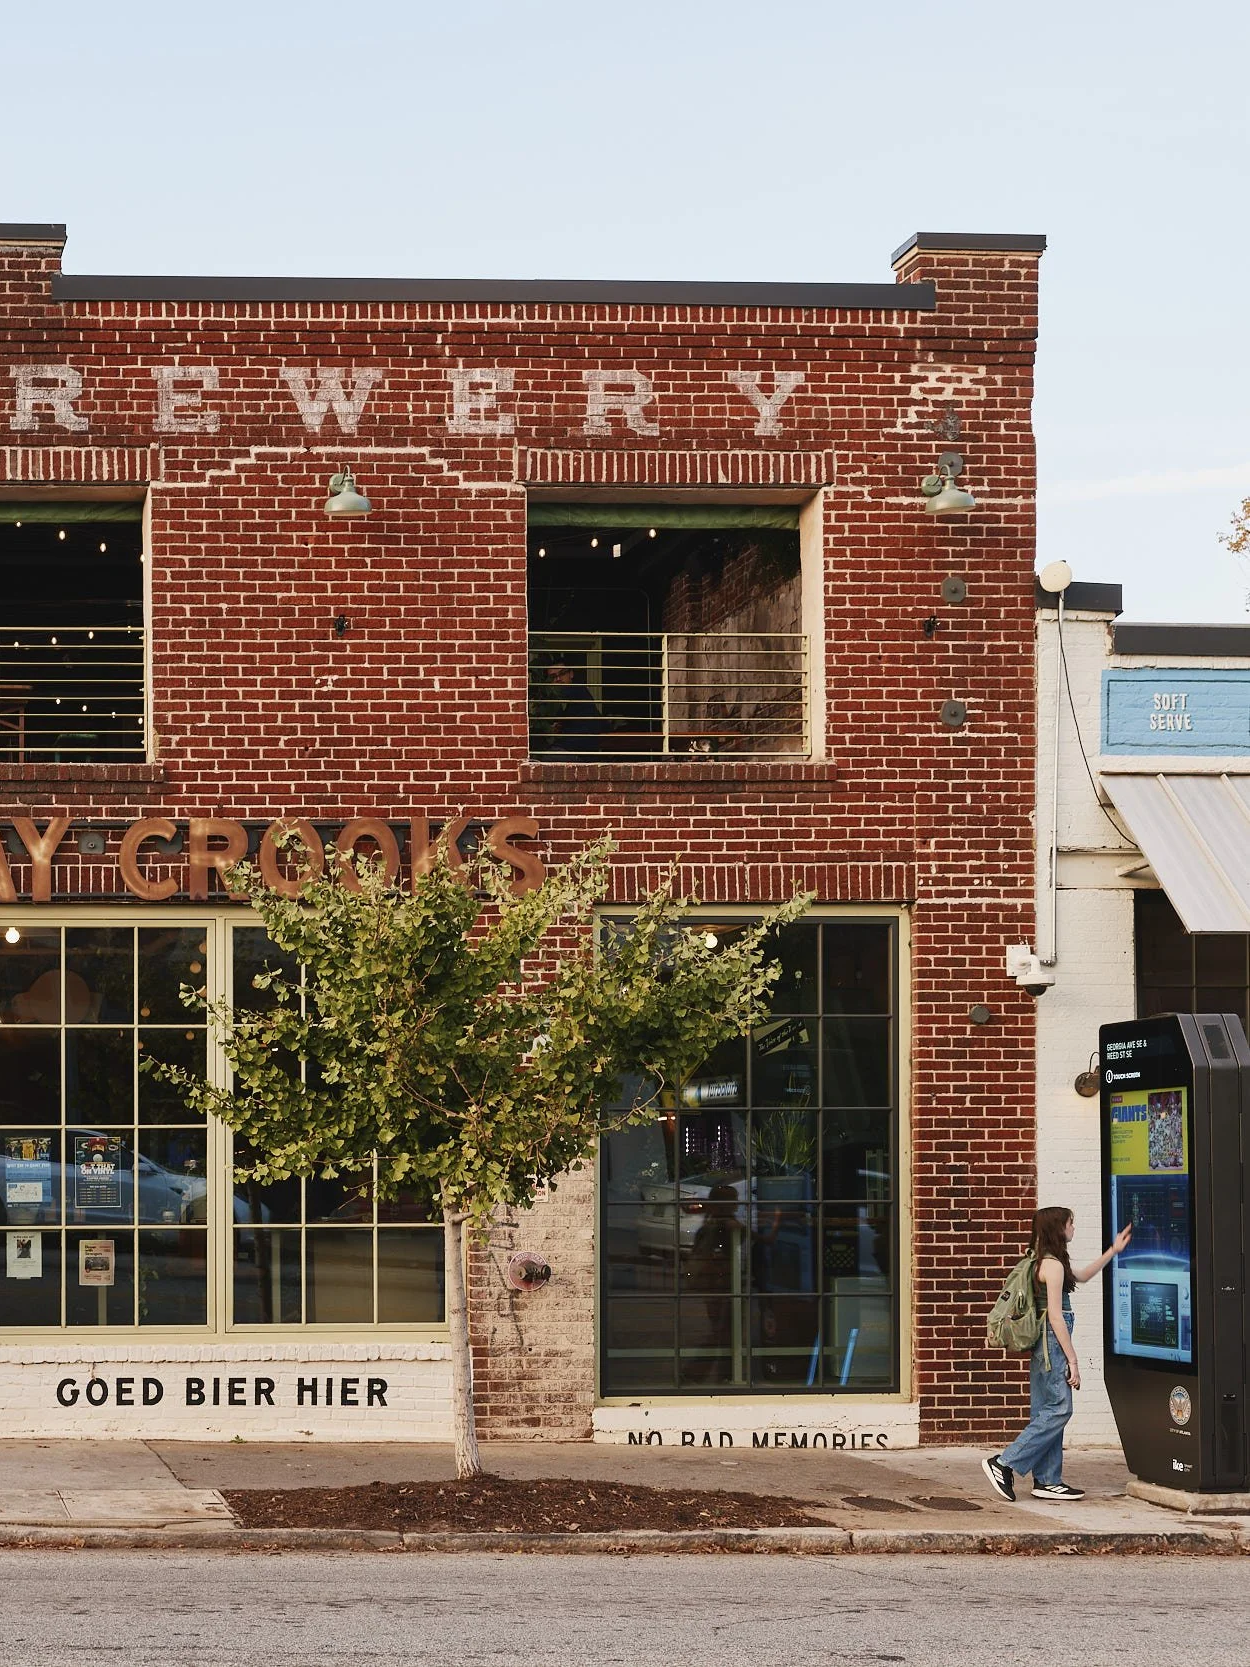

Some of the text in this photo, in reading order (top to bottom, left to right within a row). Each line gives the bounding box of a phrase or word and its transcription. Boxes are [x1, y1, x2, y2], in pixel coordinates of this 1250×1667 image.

[1153, 692, 1188, 711] SOFT
[1150, 713, 1192, 731] SERVE
[119, 816, 547, 901] CROOKS
[1106, 1039, 1147, 1052] GEORGIA AVE SE &
[1106, 1050, 1133, 1060] REED ST SE
[1111, 1104, 1147, 1123] GIANTS
[56, 1377, 388, 1406] GOED BIER HIER
[628, 1431, 888, 1449] NO BAD MEMORIES
